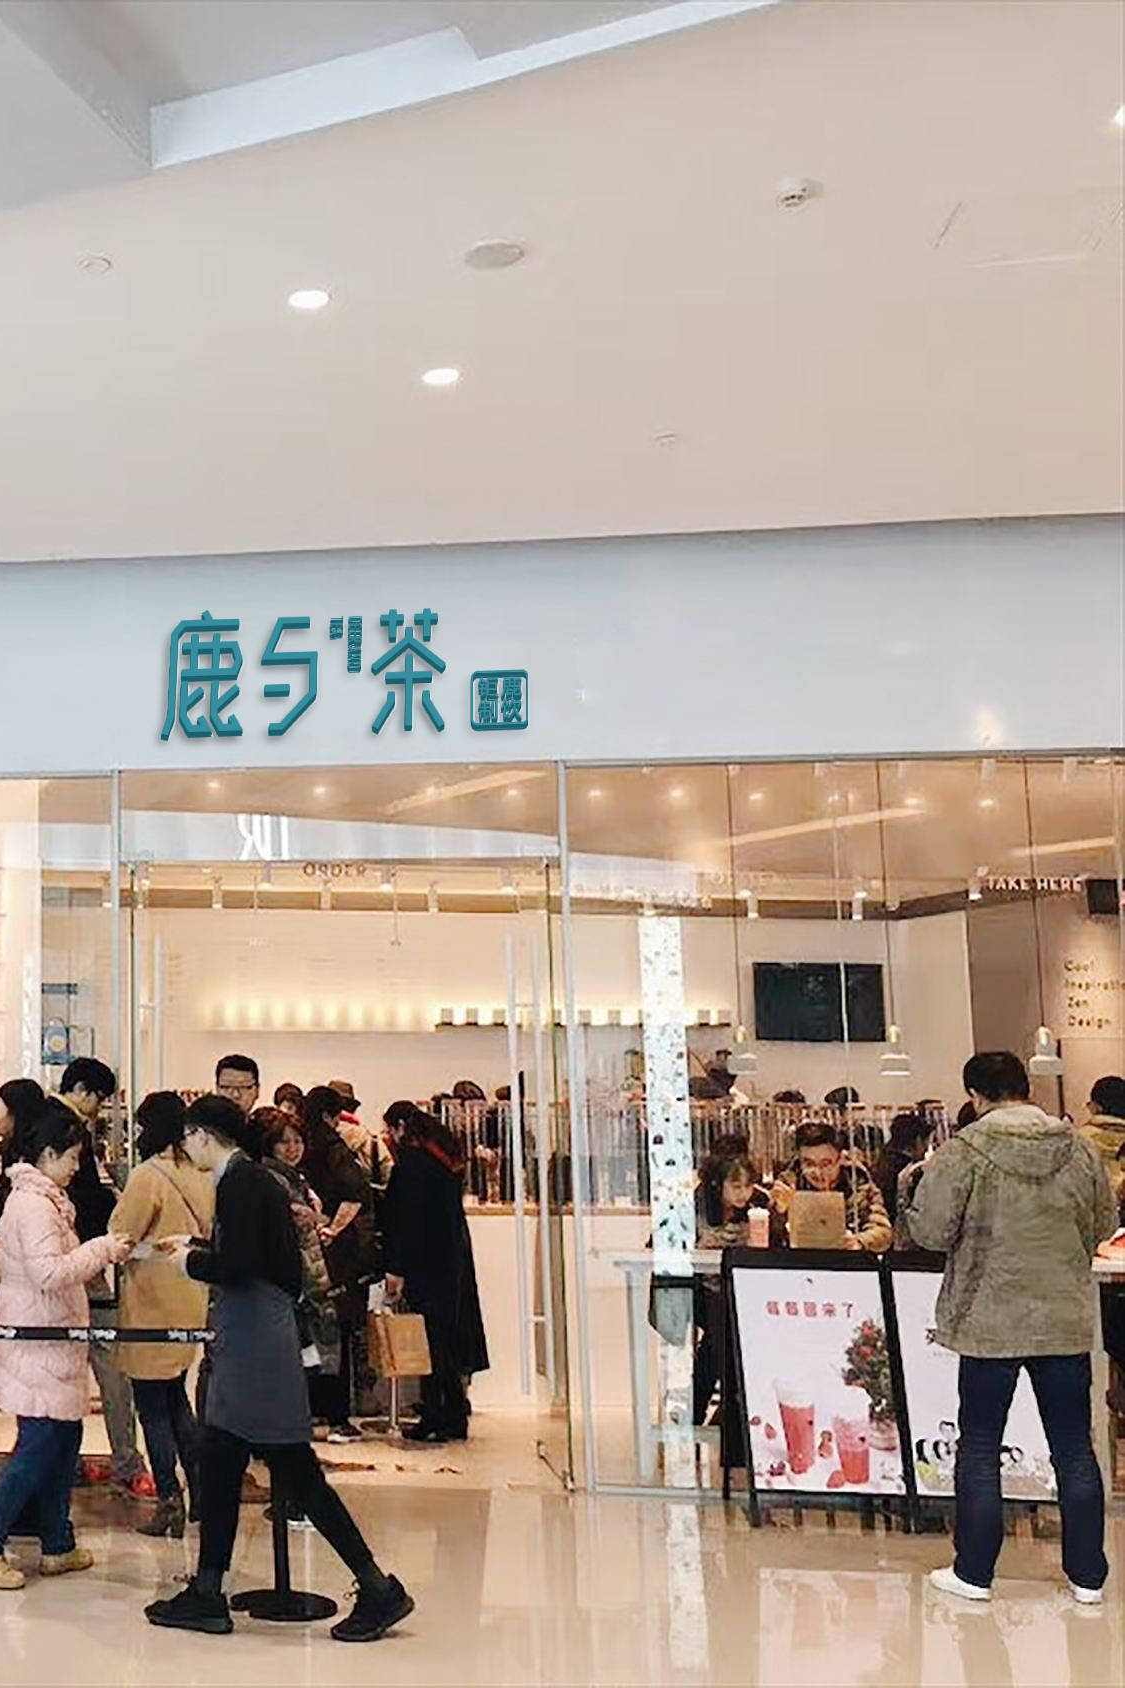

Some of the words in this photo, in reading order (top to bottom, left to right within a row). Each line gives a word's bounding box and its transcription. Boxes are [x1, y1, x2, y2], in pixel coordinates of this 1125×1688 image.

[160, 608, 446, 741] 鹿与茶
[303, 861, 366, 878] ORDER
[987, 876, 1030, 890] TAKE
[1036, 876, 1082, 892] HERE
